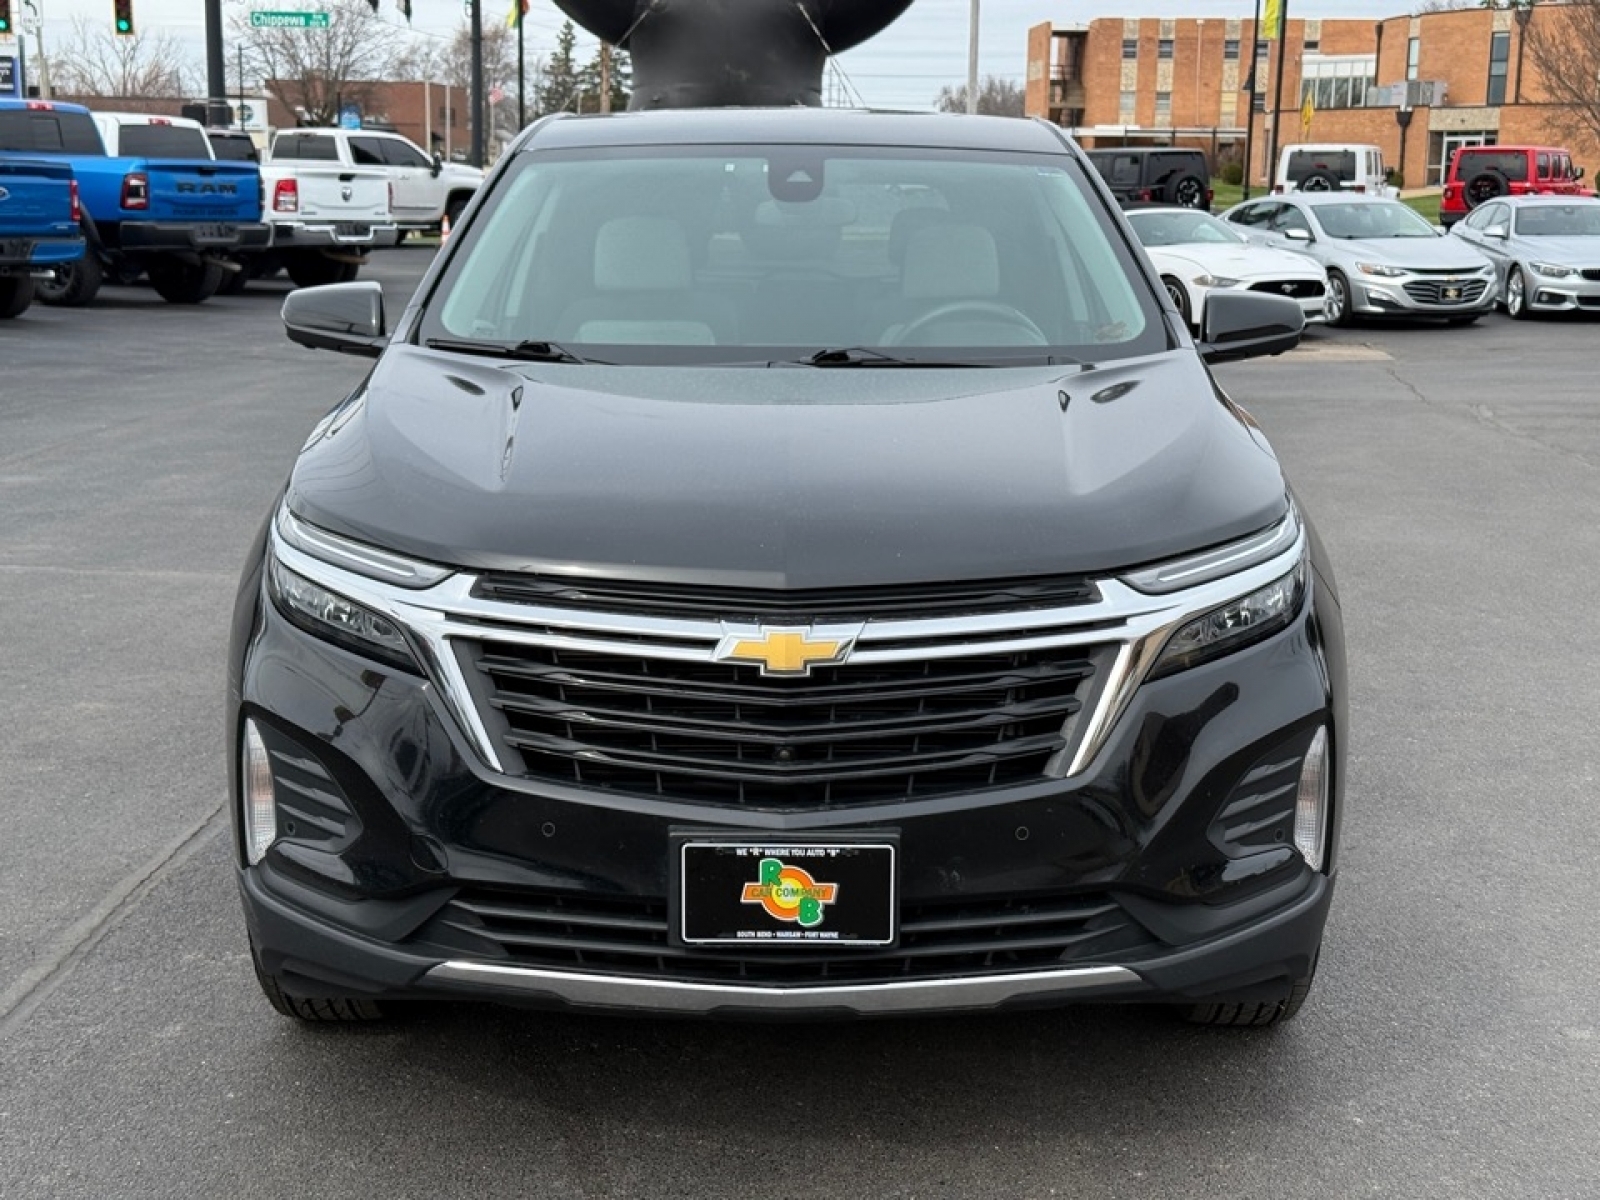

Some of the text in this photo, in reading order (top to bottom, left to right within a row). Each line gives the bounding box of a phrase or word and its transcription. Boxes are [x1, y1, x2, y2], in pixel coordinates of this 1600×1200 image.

[252, 12, 305, 26] Chippewa
[176, 182, 237, 194] RAM
[736, 847, 748, 856] WE
[764, 848, 790, 856] WHERE
[791, 848, 805, 856] YOU
[806, 848, 825, 856] AUTO
[760, 859, 783, 886] R
[751, 887, 827, 898] CAR COMPANY
[798, 895, 821, 924] B
[736, 931, 756, 939] SOUTH
[756, 931, 773, 939] BEND
[775, 931, 801, 939] WARSAW
